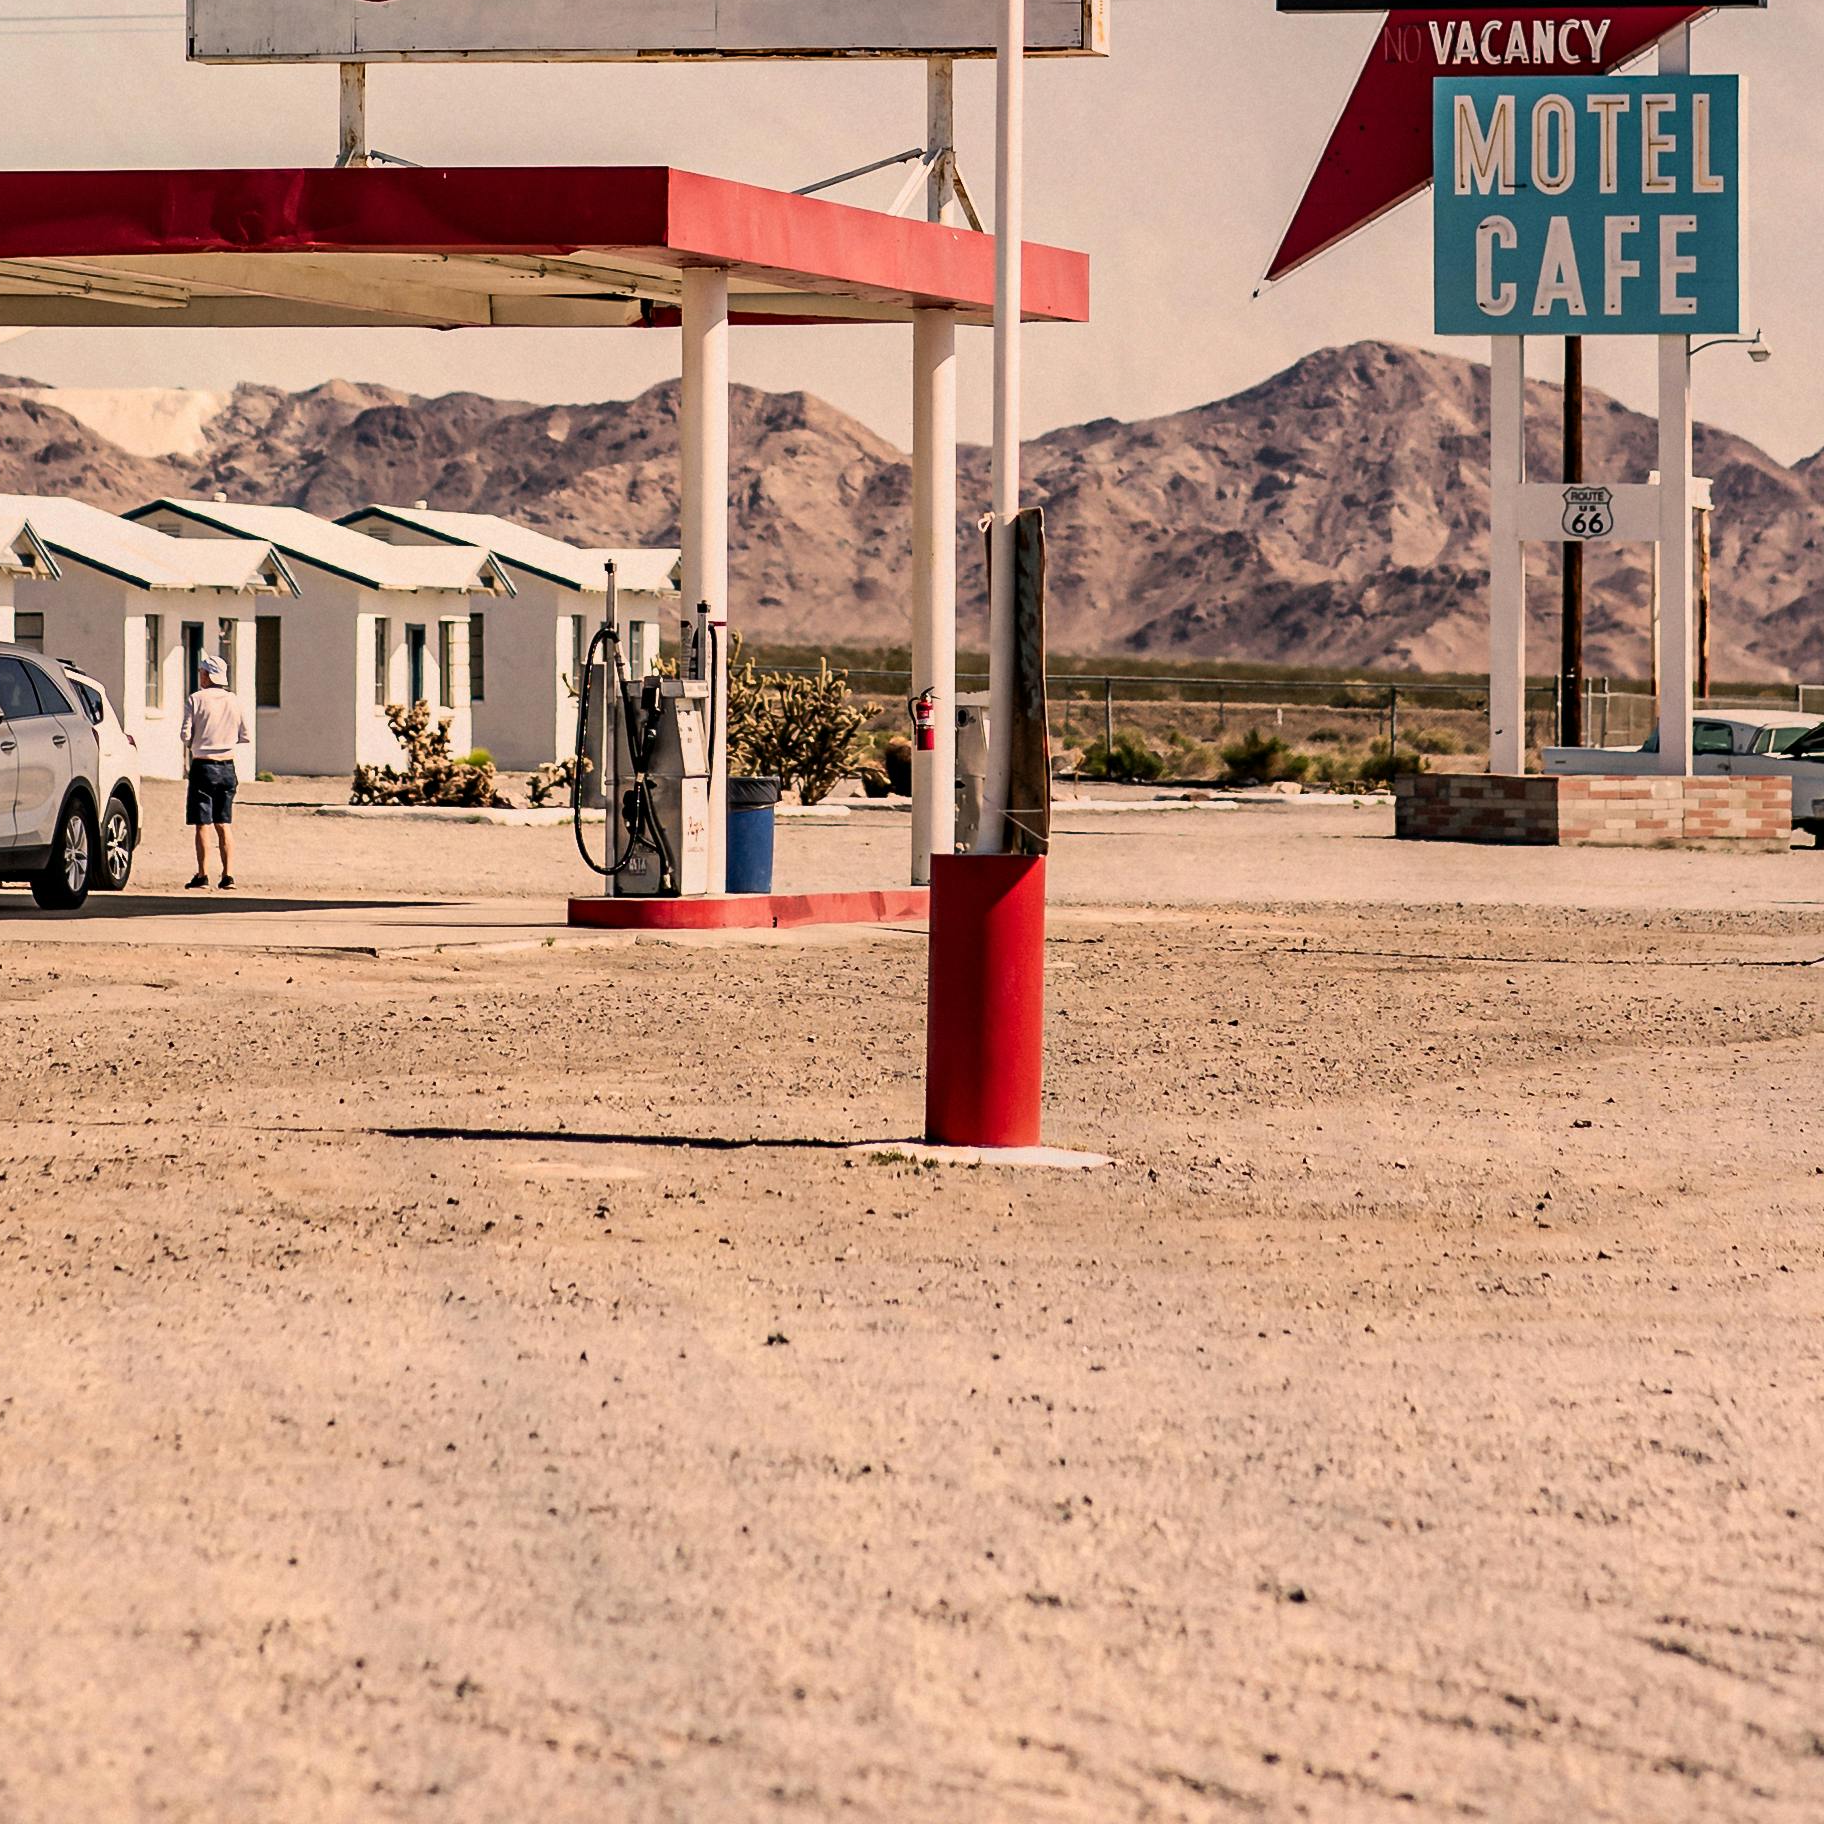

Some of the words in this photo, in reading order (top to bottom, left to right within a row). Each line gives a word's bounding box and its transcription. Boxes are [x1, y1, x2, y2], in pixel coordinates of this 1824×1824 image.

[1384, 25, 1422, 63] NO
[1428, 19, 1611, 65] VACANCY
[1453, 93, 1725, 196] MOTEL
[1475, 214, 1698, 317] CAFE
[1570, 491, 1605, 502] ROUTE
[1571, 512, 1604, 534] 66
